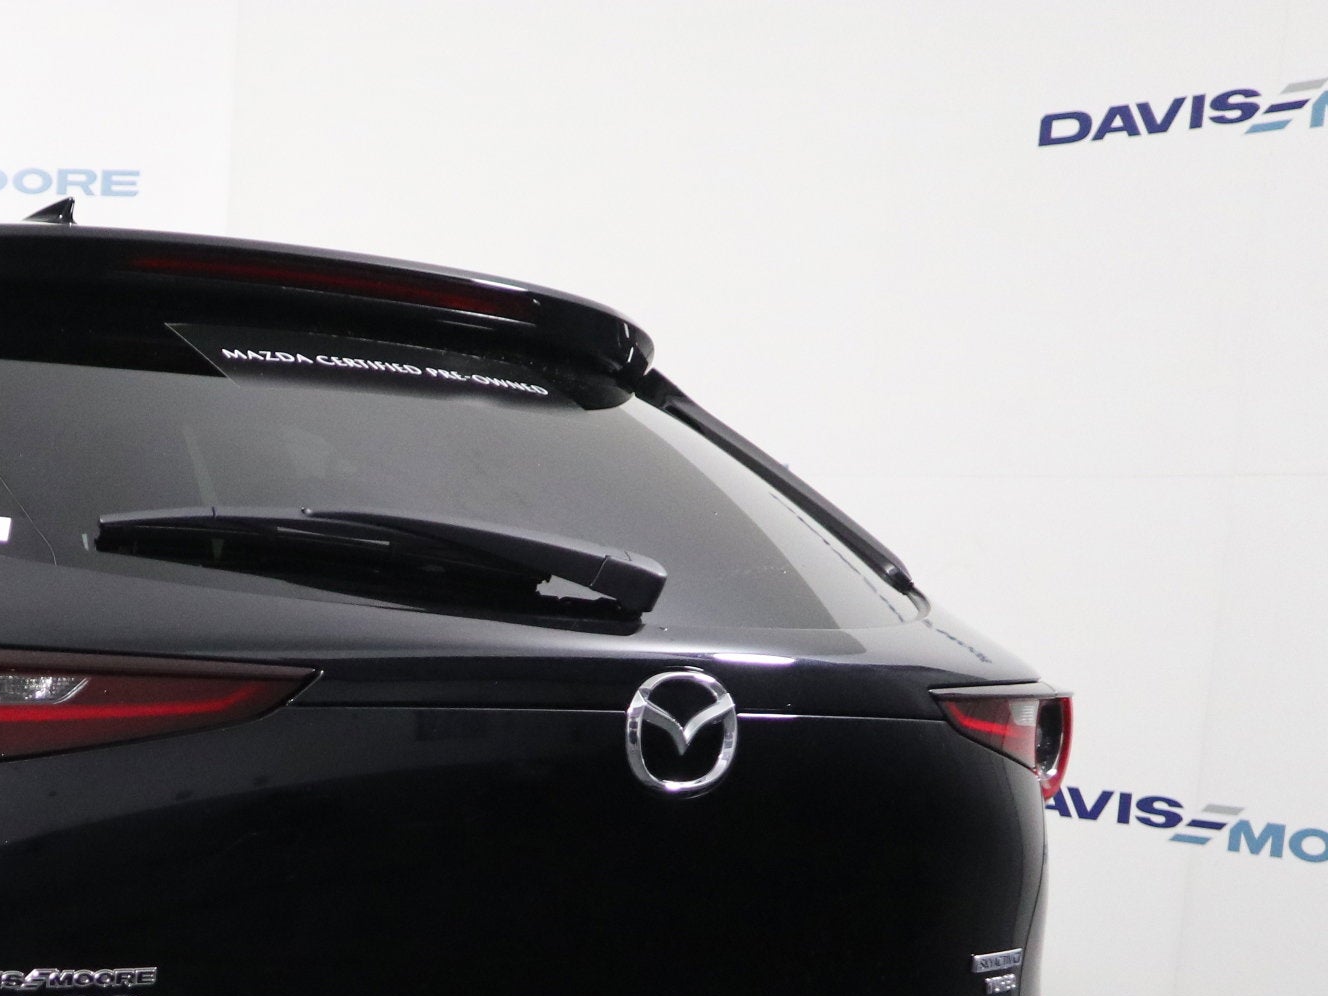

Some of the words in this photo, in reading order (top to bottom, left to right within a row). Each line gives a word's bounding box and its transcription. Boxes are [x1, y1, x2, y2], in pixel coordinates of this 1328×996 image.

[222, 349, 313, 364] MAZDA
[317, 355, 423, 375] CERTIFIED
[426, 367, 549, 395] PRE-OWNED
